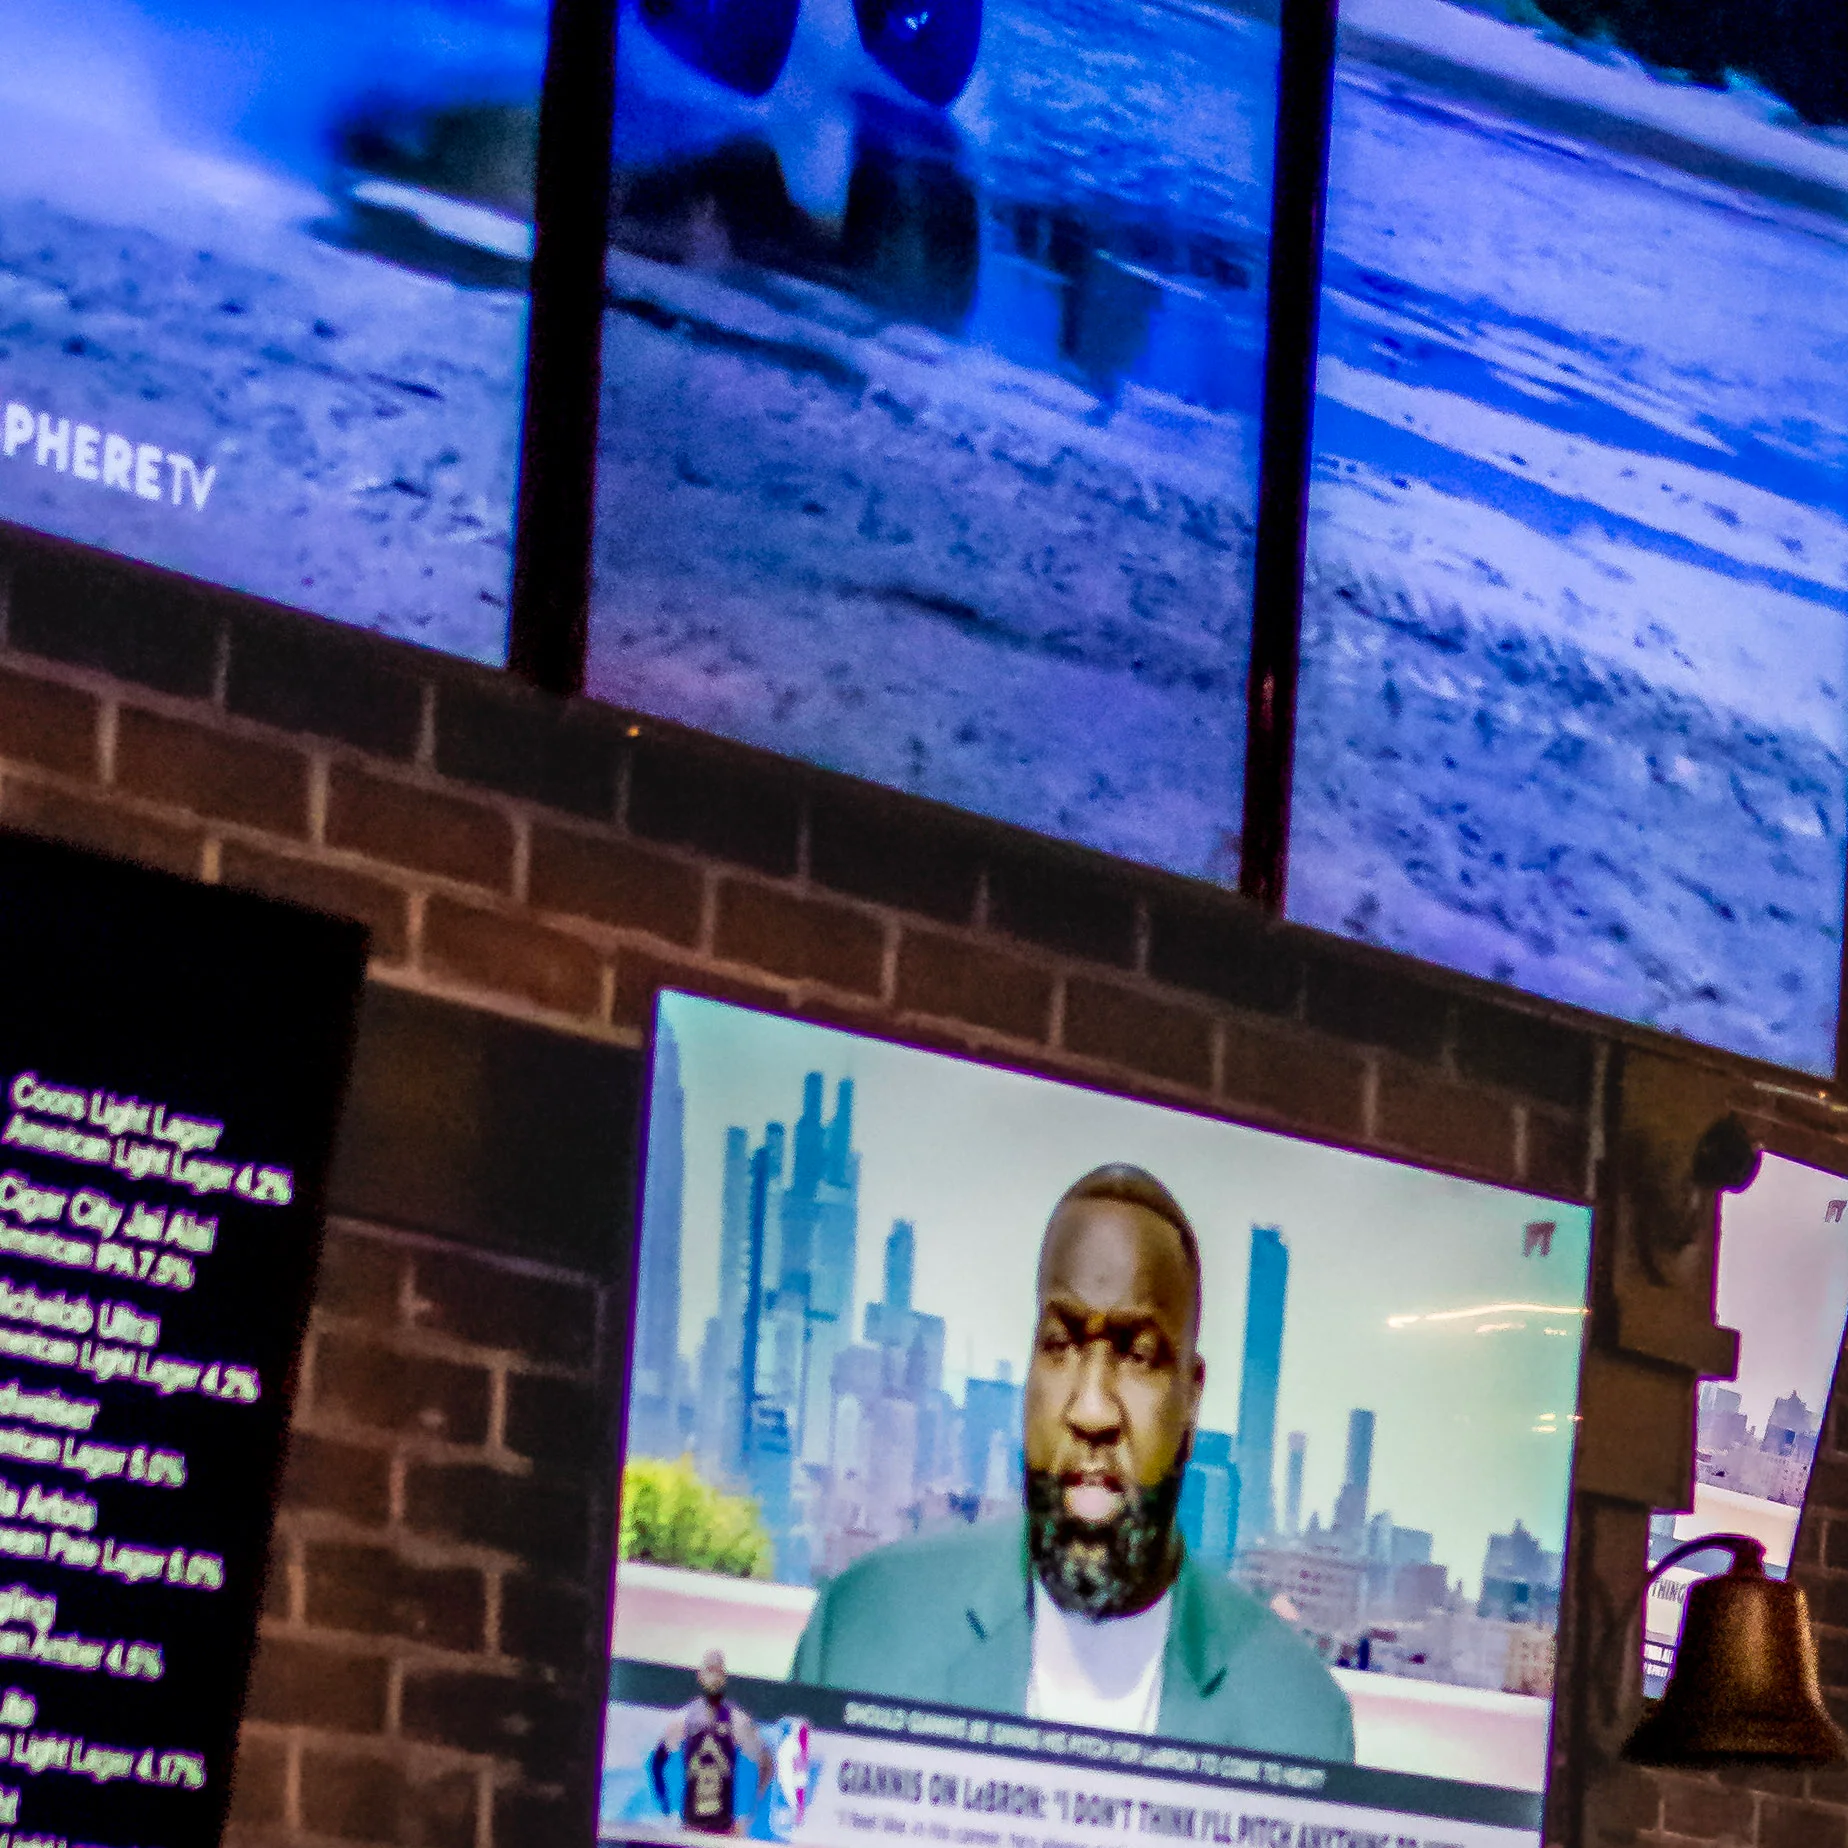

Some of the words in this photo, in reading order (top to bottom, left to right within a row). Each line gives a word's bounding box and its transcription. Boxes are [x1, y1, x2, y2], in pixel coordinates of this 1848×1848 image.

[838, 1759, 922, 1804] GIANNIS
[929, 1772, 958, 1806] ON
[1074, 1792, 1131, 1831] DON'T
[1139, 1801, 1196, 1840] THINK
